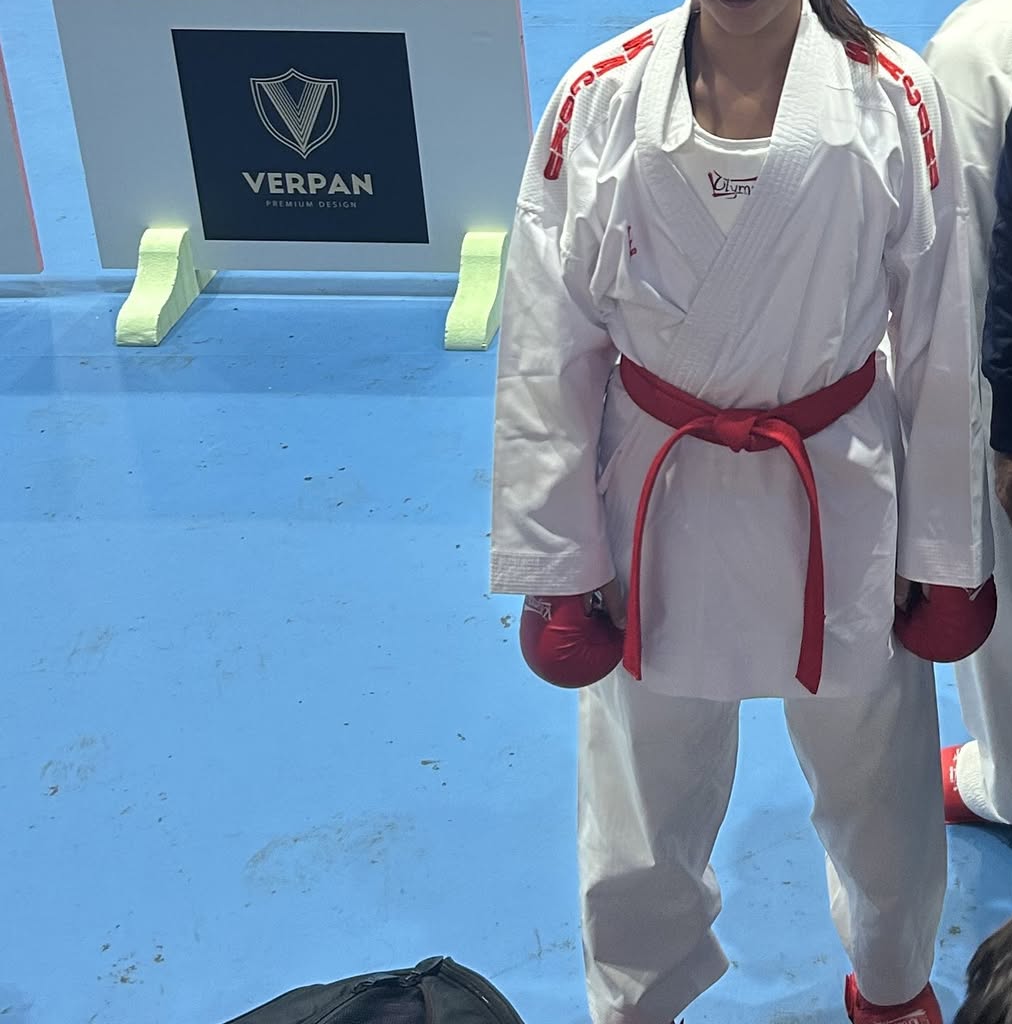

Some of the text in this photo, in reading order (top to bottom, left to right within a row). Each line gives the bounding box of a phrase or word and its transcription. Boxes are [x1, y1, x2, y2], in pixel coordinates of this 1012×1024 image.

[242, 172, 374, 195] VERPAN
[266, 200, 357, 209] PREMIUM DESIGN
